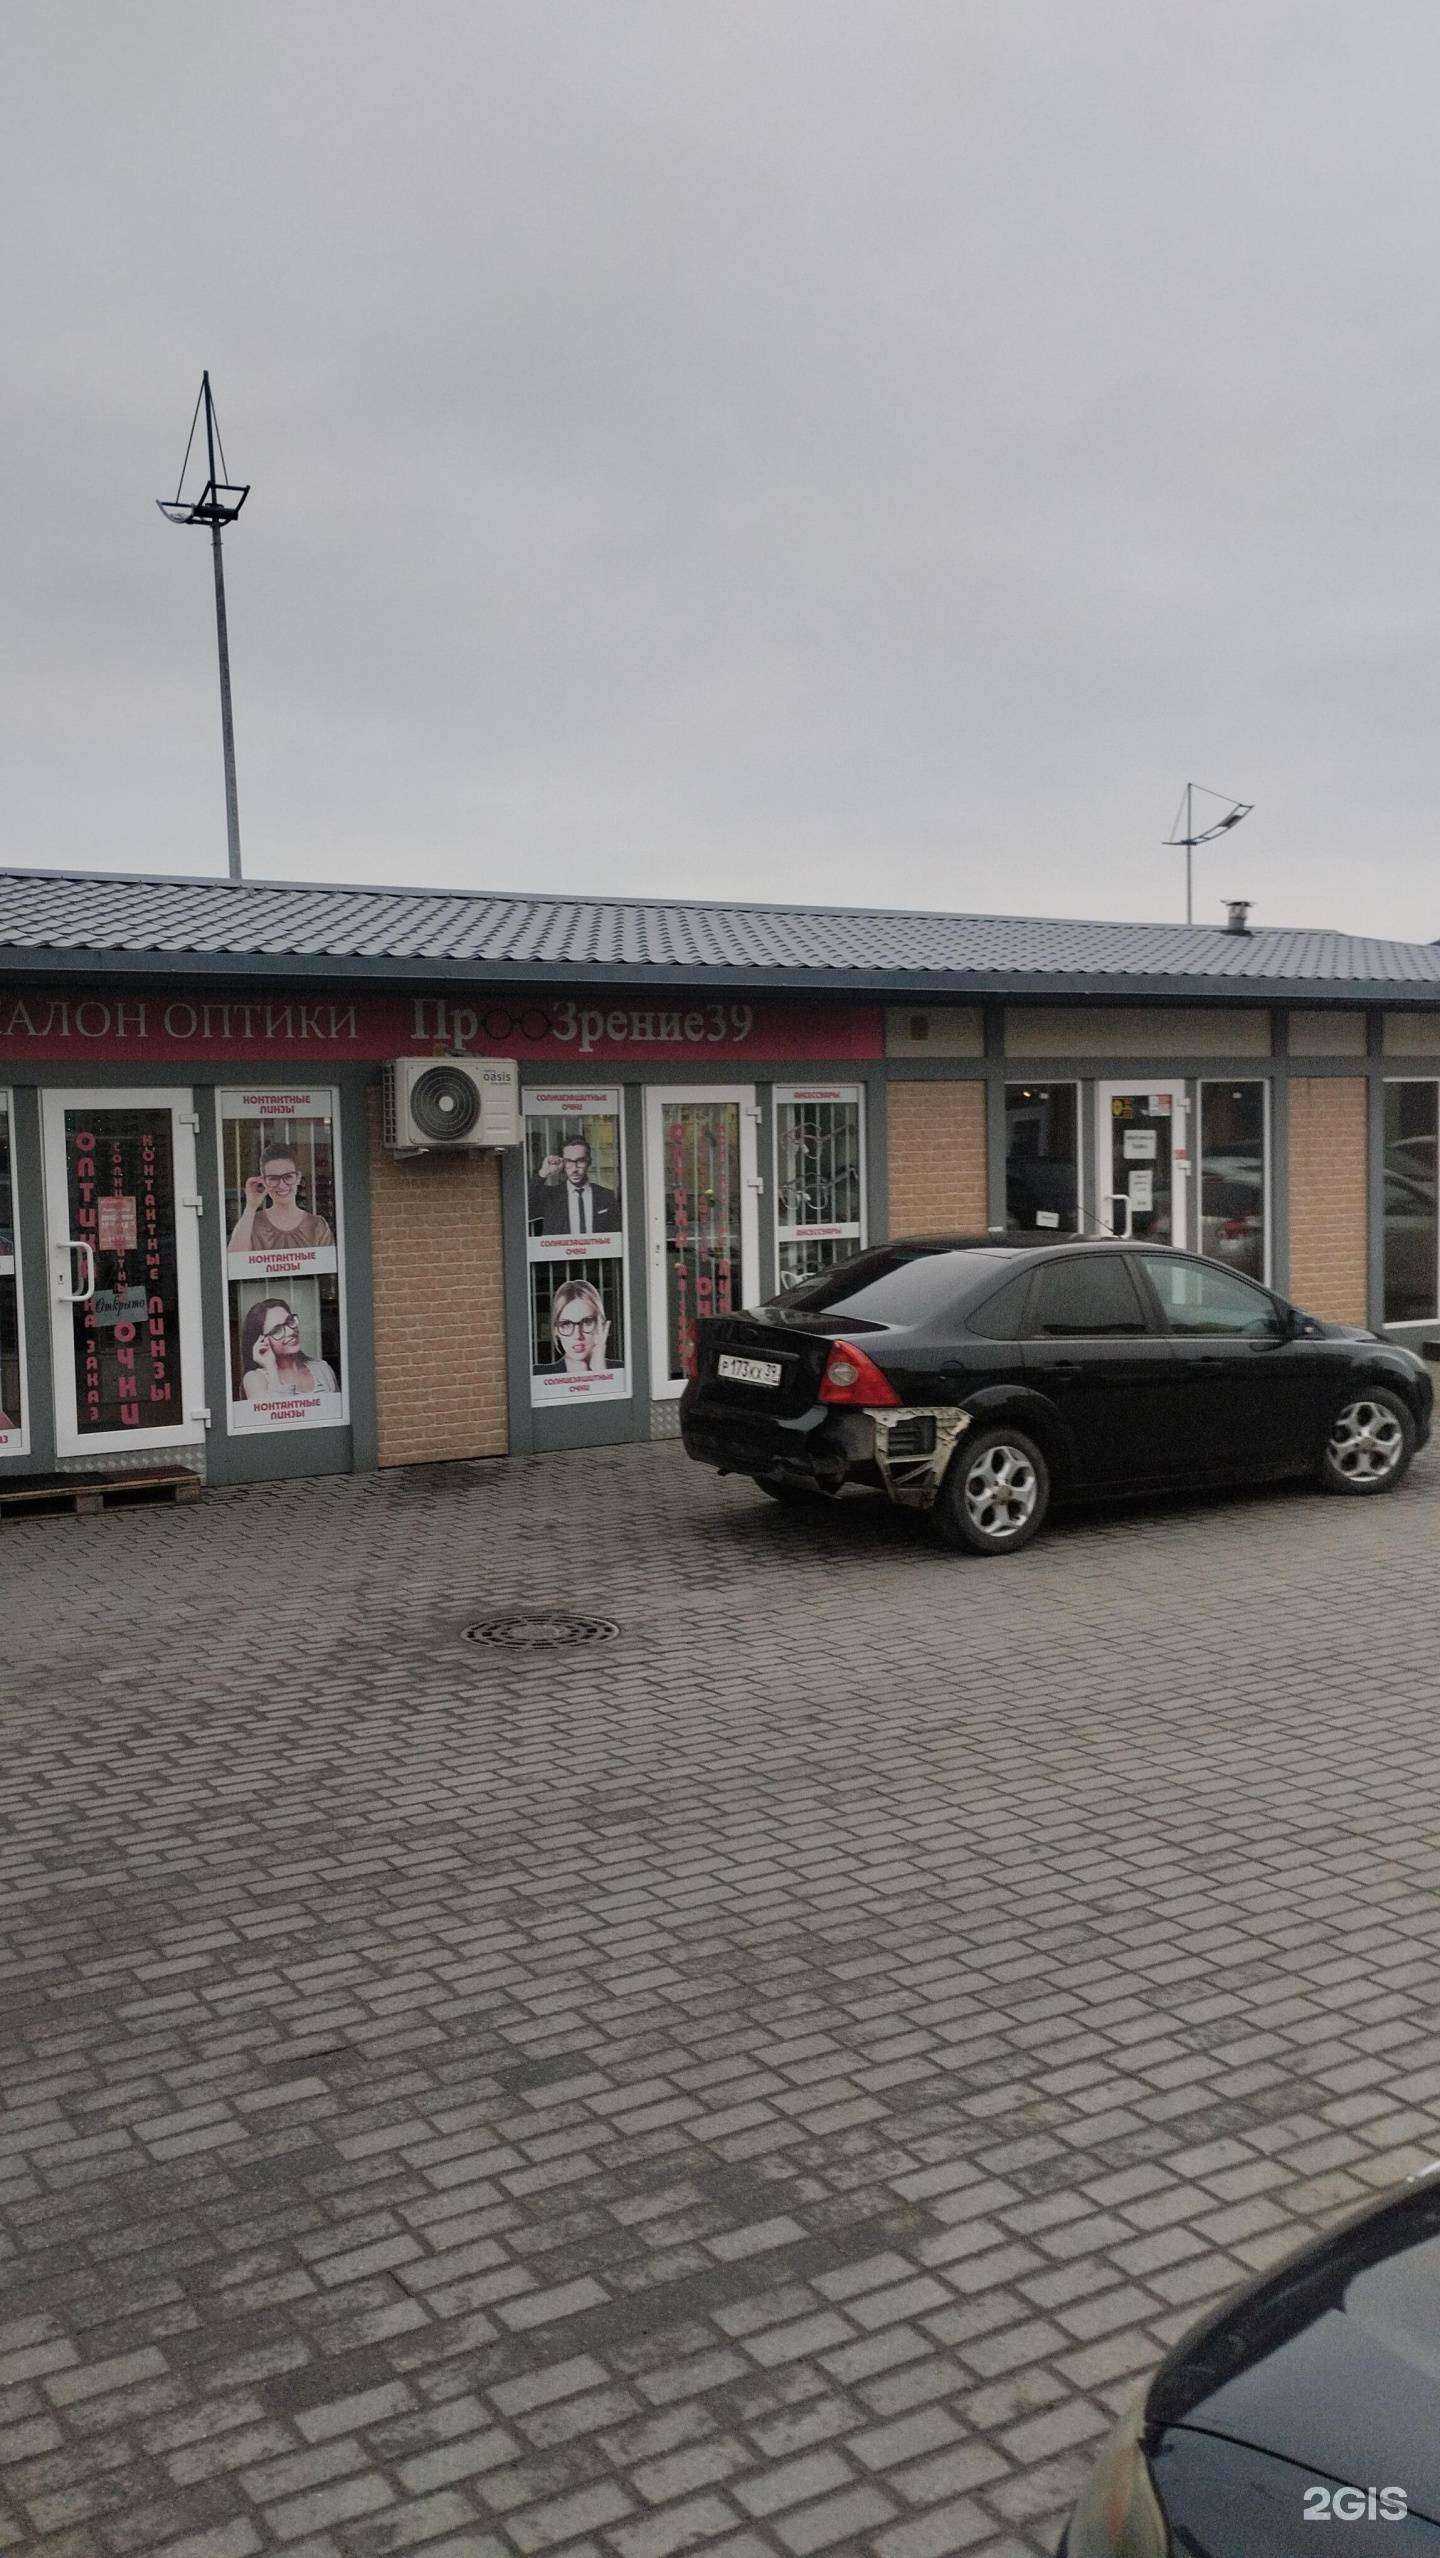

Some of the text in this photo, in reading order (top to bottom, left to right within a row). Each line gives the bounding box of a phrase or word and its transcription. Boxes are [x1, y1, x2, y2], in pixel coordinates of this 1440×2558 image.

[0, 1000, 359, 1039] АЛОН ОПТИКИ
[483, 1071, 512, 1082] oasis
[243, 1095, 311, 1105] КОНТАКТНЫЕ
[260, 1105, 295, 1114] ЛИНЗЫ
[248, 1252, 317, 1264] КОНТАКТНЫЕ
[266, 1263, 301, 1273] ЛИНЗЫ
[149, 1295, 172, 1401] ЛИНЗЫ
[114, 1321, 139, 1425] ОЧКИ
[253, 1398, 321, 1411] КОНТАКТНЫЕ
[270, 1410, 305, 1420] ЛИНЗЫ
